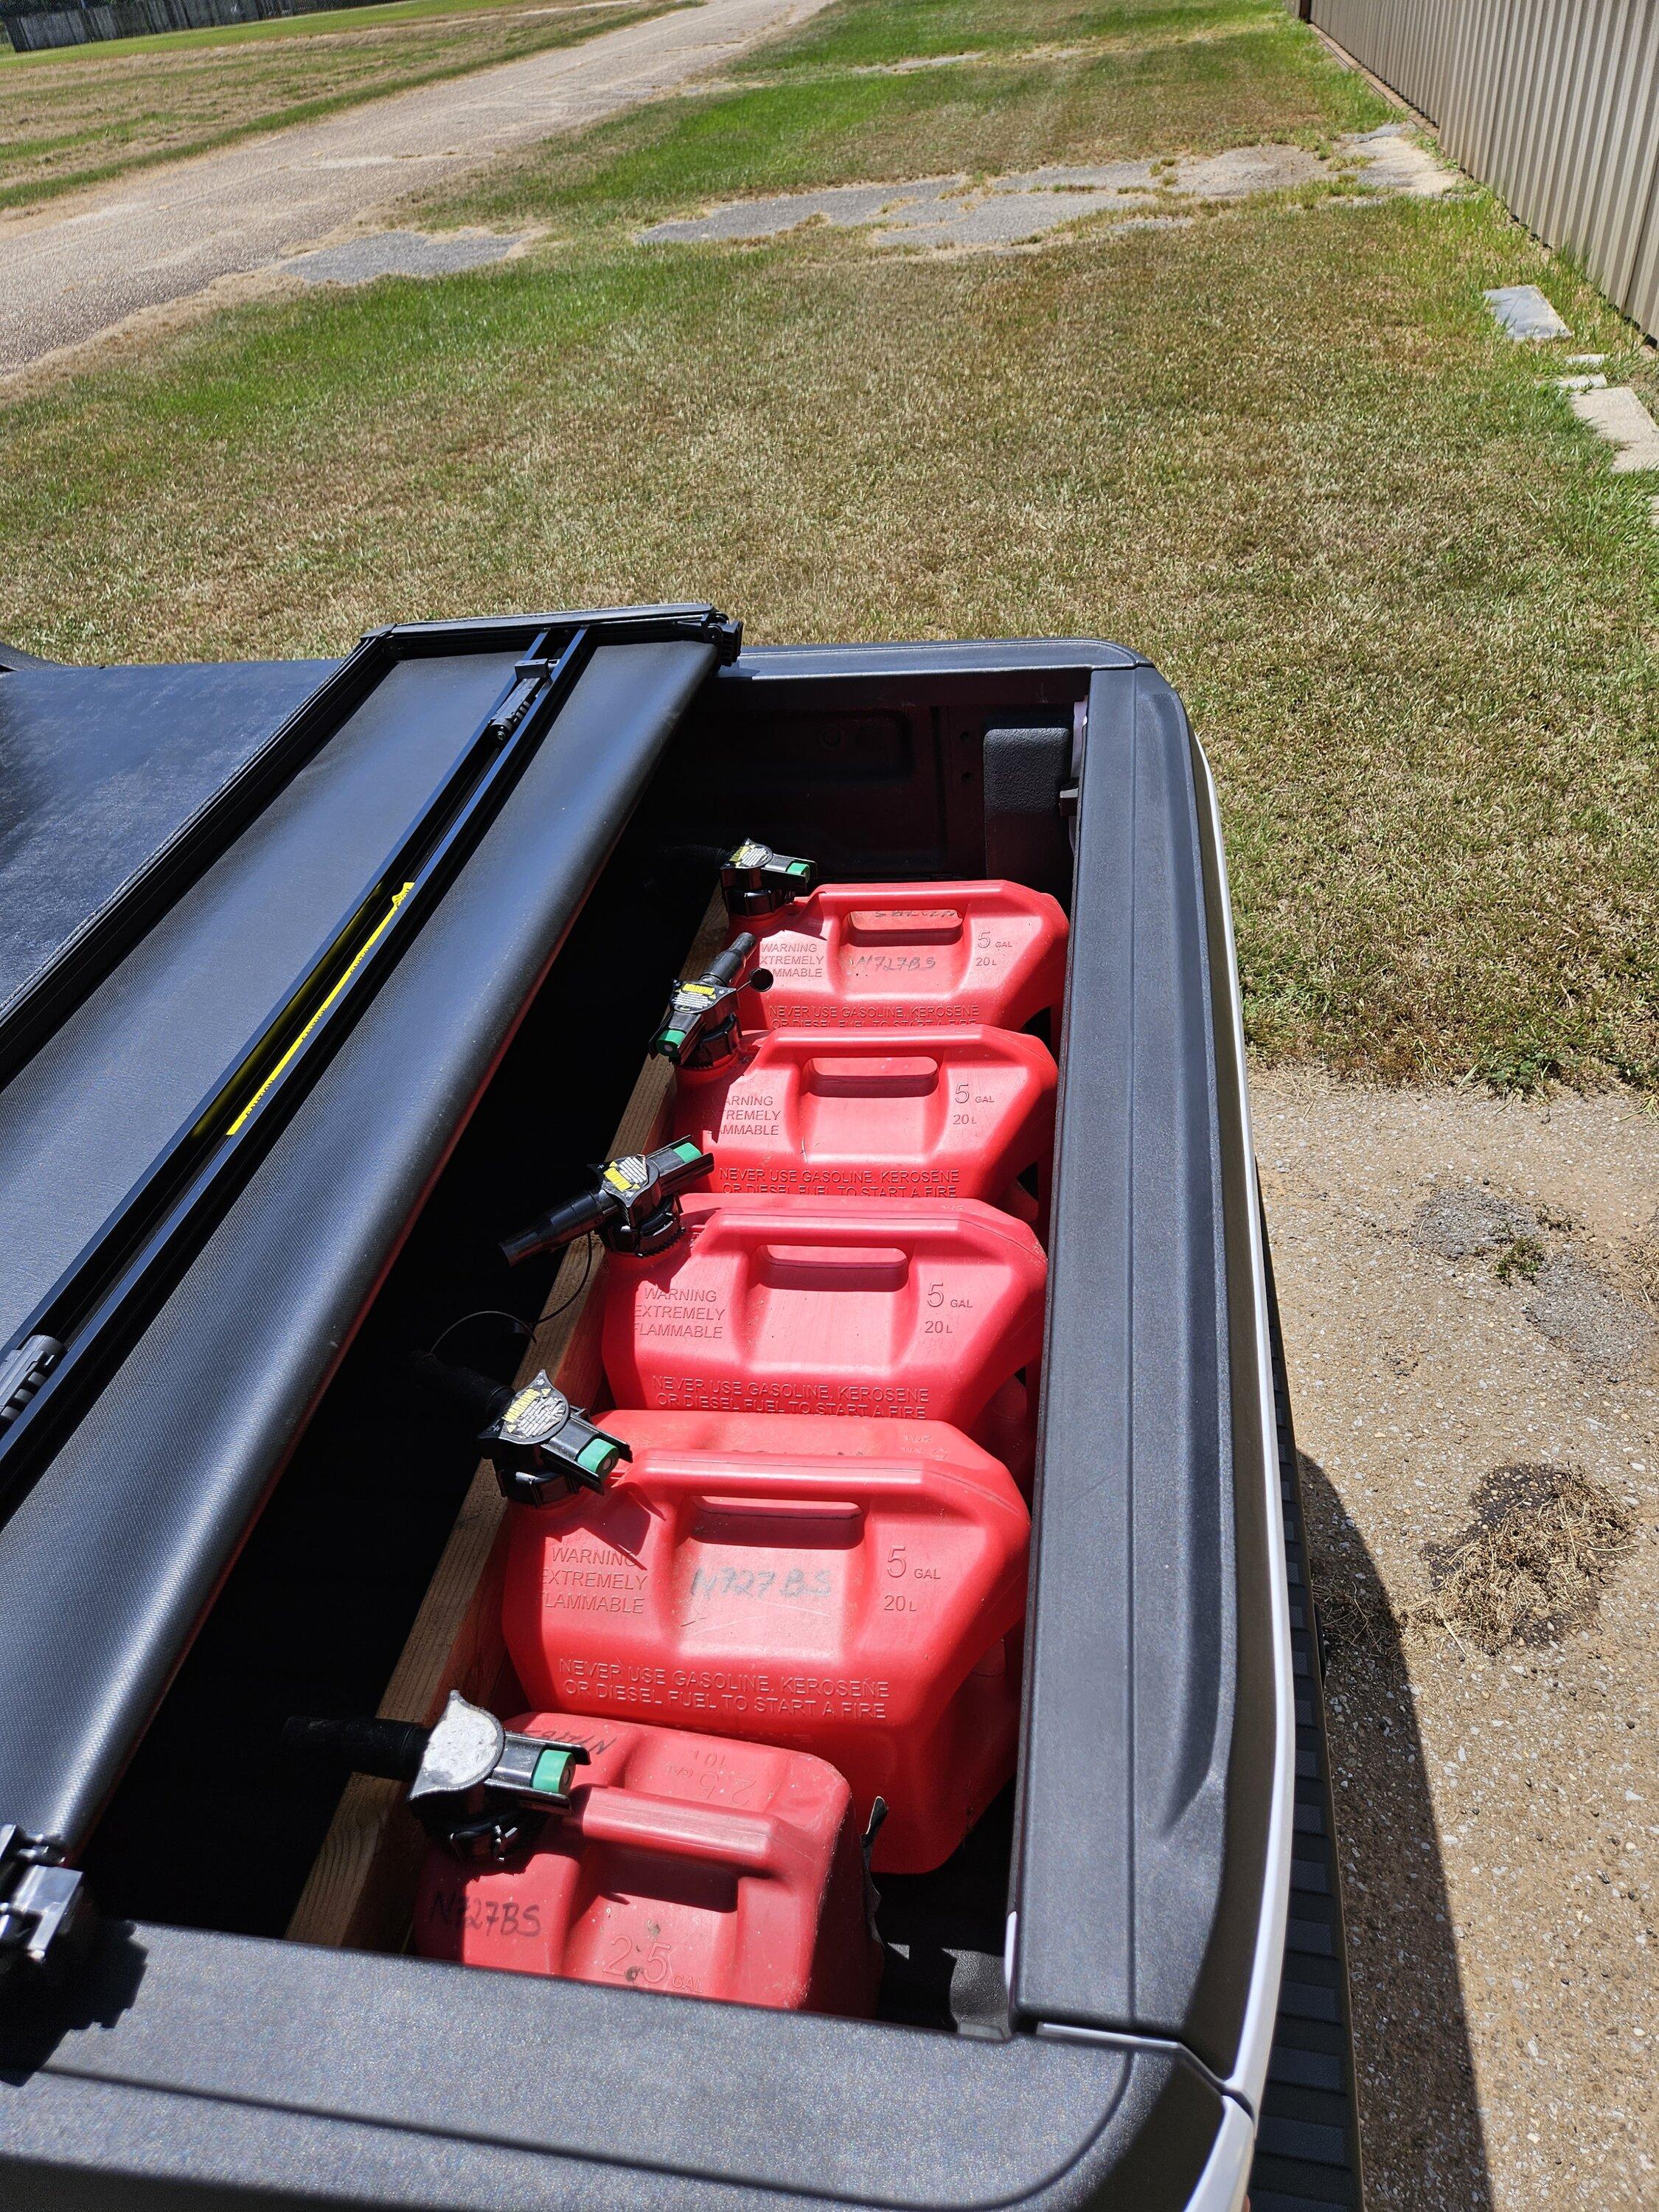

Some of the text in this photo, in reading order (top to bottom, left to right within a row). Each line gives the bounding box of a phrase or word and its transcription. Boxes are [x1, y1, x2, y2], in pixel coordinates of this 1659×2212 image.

[762, 942, 818, 953] WARNING
[978, 931, 991, 949] 5
[759, 955, 824, 965] XTREMELY
[975, 957, 990, 967] 20
[769, 1005, 810, 1018] NEVER
[812, 1005, 838, 1018] USE
[911, 1004, 980, 1018] KEROSENE
[955, 1082, 970, 1104] 5
[953, 1114, 970, 1124] 20
[720, 1167, 765, 1181] NEVER
[770, 1169, 798, 1183] USE
[881, 1169, 959, 1183] KEROSENE
[723, 1182, 742, 1194] OR
[925, 1185, 958, 1198] FIRE
[644, 1287, 717, 1303] WARNING
[927, 1282, 973, 1308] 5 GAL
[634, 1304, 726, 1321] EXTREMELY
[925, 1320, 944, 1334] 20
[653, 1374, 706, 1393] NEVER
[710, 1379, 742, 1395] USE
[838, 1385, 930, 1403] KEROSENE
[656, 1391, 927, 1420] OR DIESEL FUEL TO START A FIRE
[887, 1545, 942, 1579] 5 GAL
[542, 1568, 649, 1590] EXTREMELY
[884, 1595, 906, 1612] 20
[560, 1658, 623, 1682] NEVER
[628, 1665, 667, 1686] USE
[781, 1676, 890, 1698] KEROSENE
[564, 1679, 886, 1719] OR DIESEL FUEL TO START A FIRE
[672, 1973, 704, 1994] GAL
